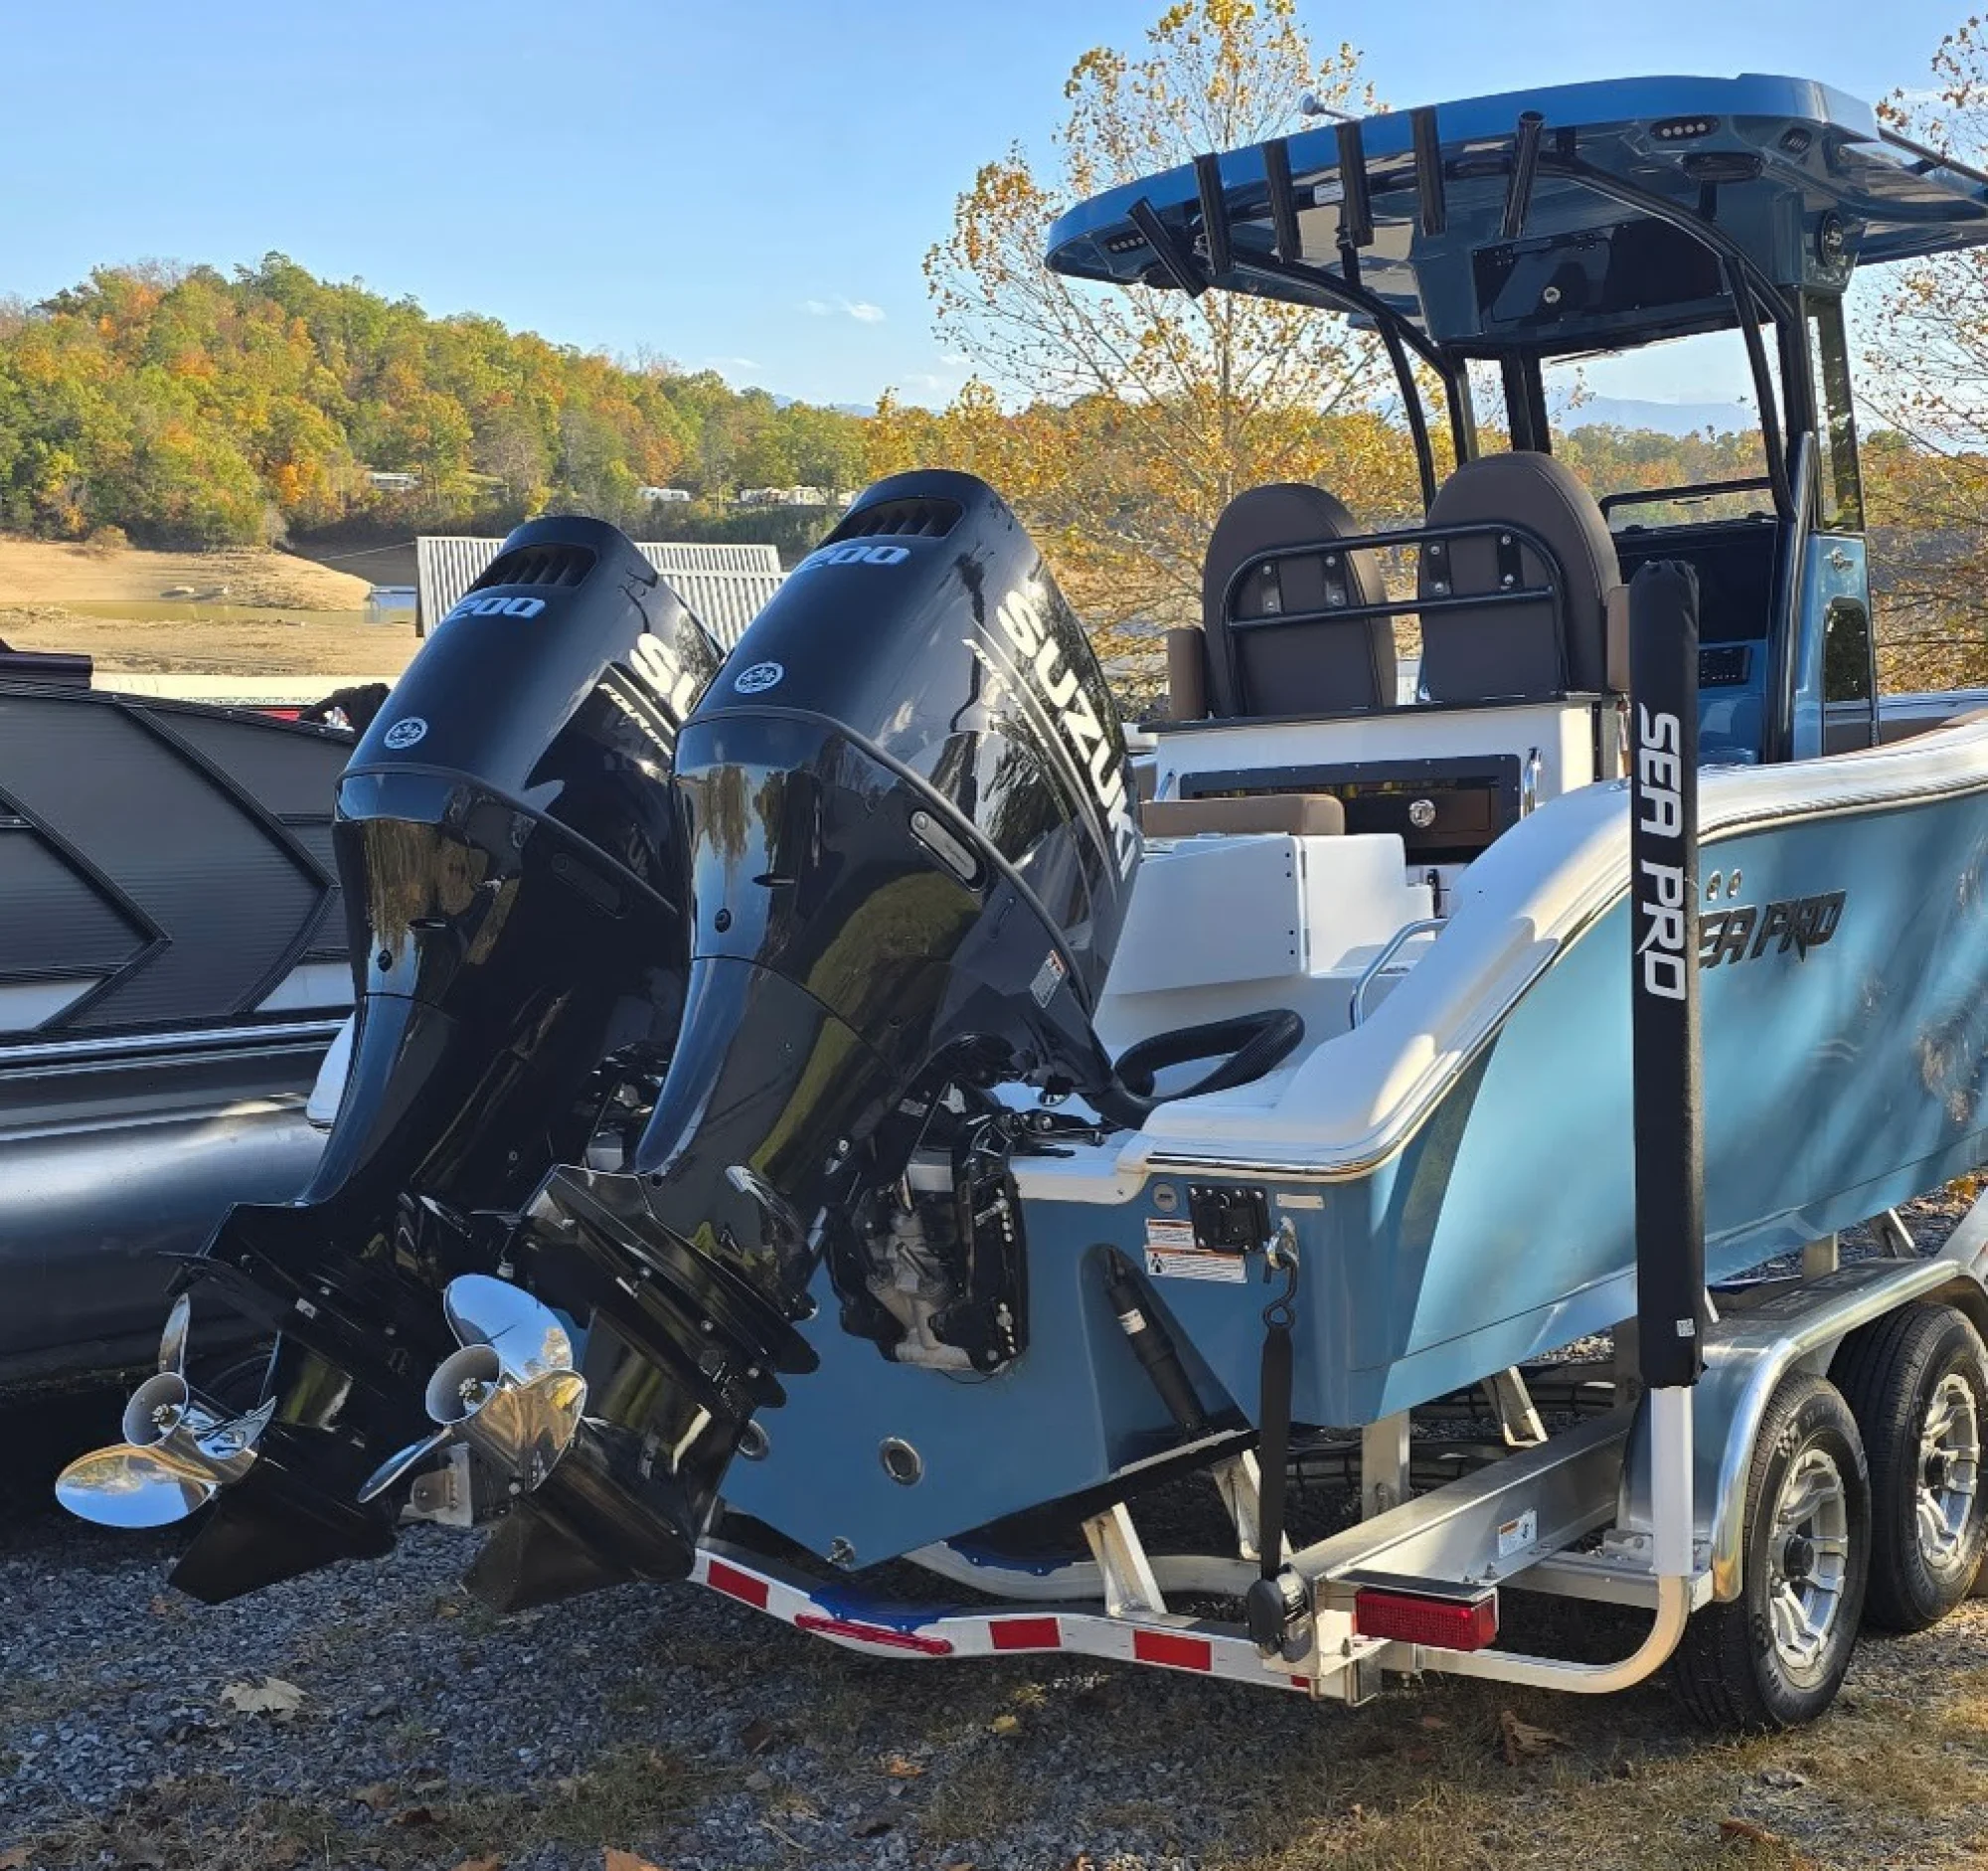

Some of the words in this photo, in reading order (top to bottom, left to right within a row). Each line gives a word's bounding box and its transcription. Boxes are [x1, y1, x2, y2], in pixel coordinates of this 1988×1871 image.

[997, 590, 1136, 881] SUZUKI
[1639, 702, 1682, 838] SEA
[1636, 859, 1687, 1001] PRO
[1699, 905, 1757, 969] EA
[1750, 889, 1847, 962] PRO
